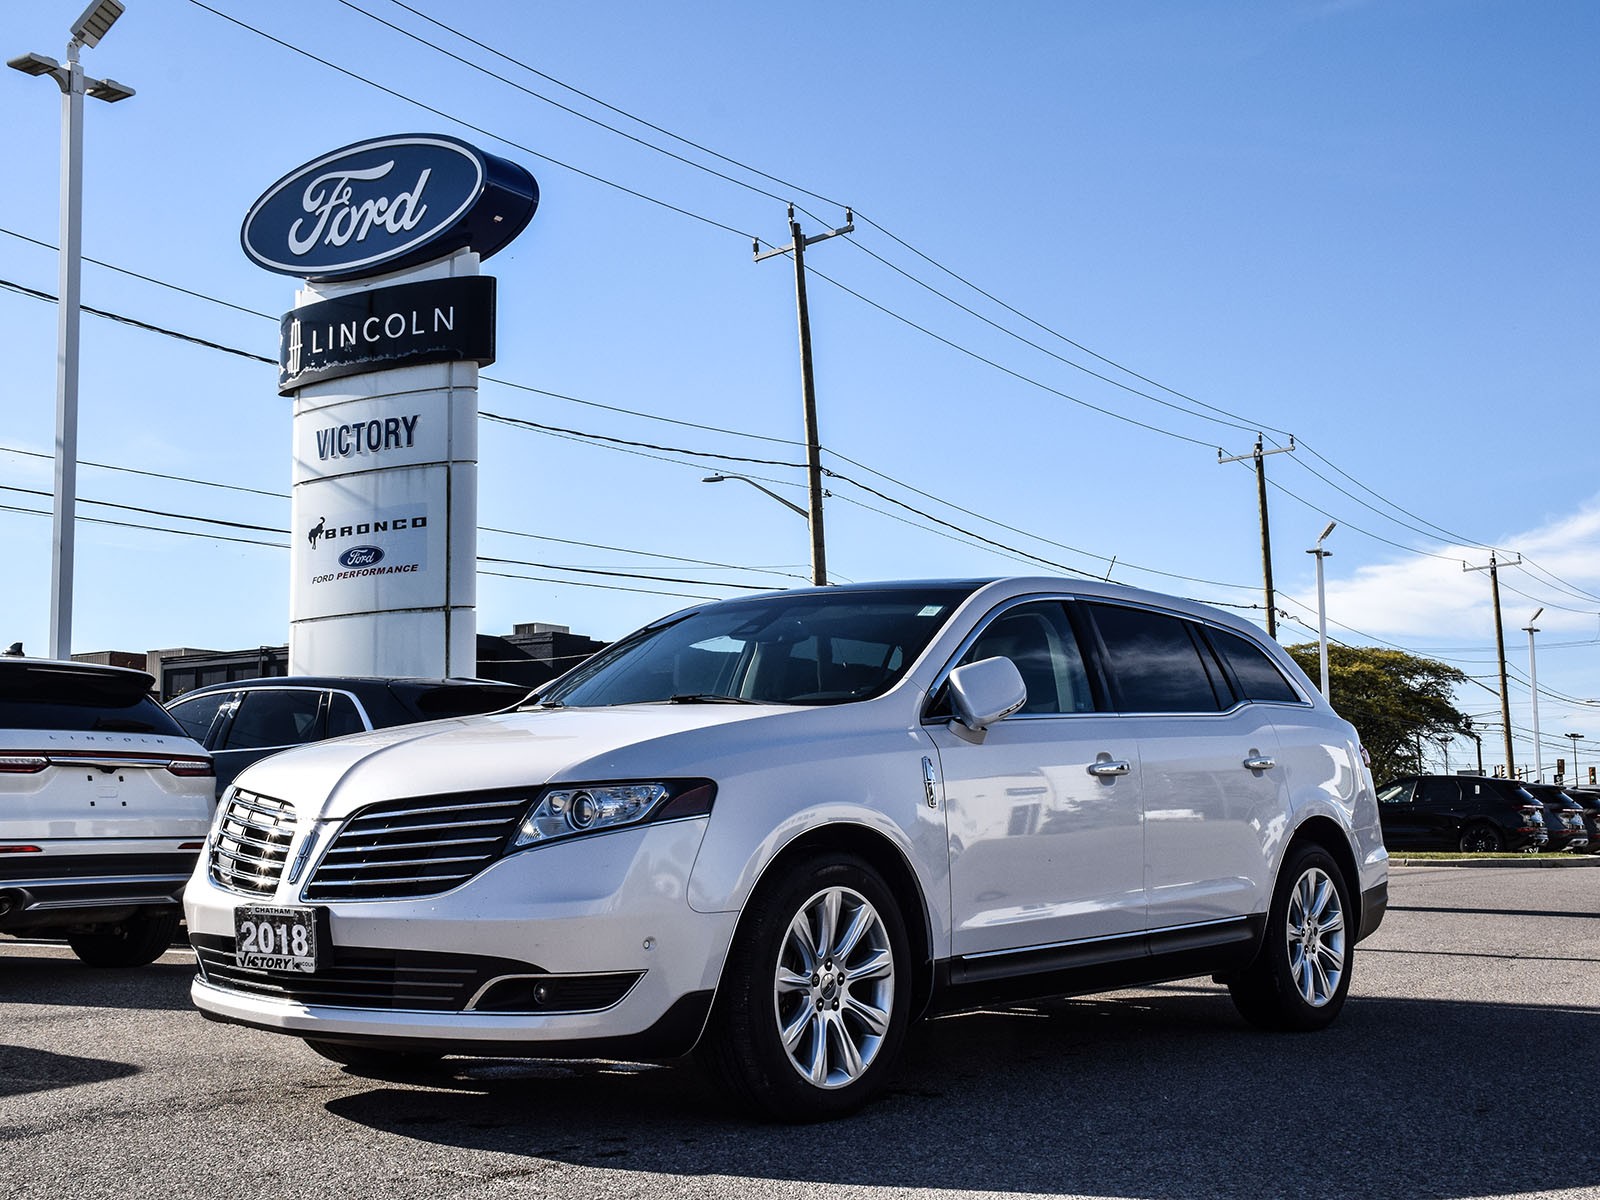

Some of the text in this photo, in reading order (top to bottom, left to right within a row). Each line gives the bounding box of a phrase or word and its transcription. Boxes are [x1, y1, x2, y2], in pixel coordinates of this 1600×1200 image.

[288, 160, 432, 255] Ford
[311, 306, 454, 353] LINCOLN
[315, 414, 421, 460] VICTORY
[325, 516, 427, 540] BRONCO
[347, 549, 375, 565] Ford
[312, 563, 419, 585] FORD PERFORMANCE
[49, 735, 165, 744] LINCOLN
[240, 921, 309, 957] 2018
[239, 951, 292, 970] VICTORY
